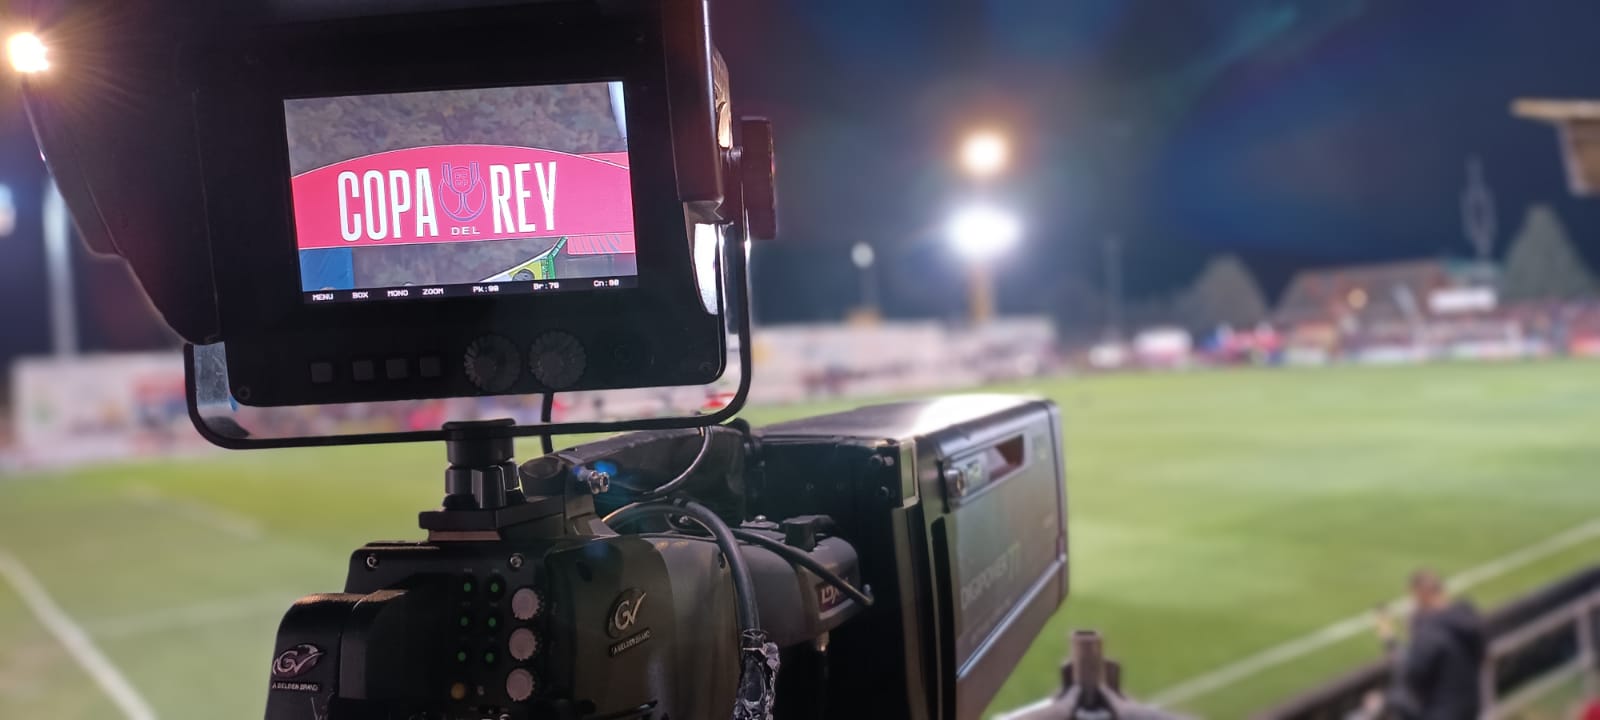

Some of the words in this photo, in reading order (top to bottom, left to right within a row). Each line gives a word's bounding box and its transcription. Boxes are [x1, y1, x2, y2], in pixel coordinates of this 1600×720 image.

[337, 168, 439, 242] COPA
[451, 226, 480, 236] DEL
[489, 161, 557, 234] REY
[312, 293, 334, 301] MENU
[352, 291, 369, 299] BOX
[387, 289, 409, 297] MONO
[422, 287, 444, 295] ZOOM
